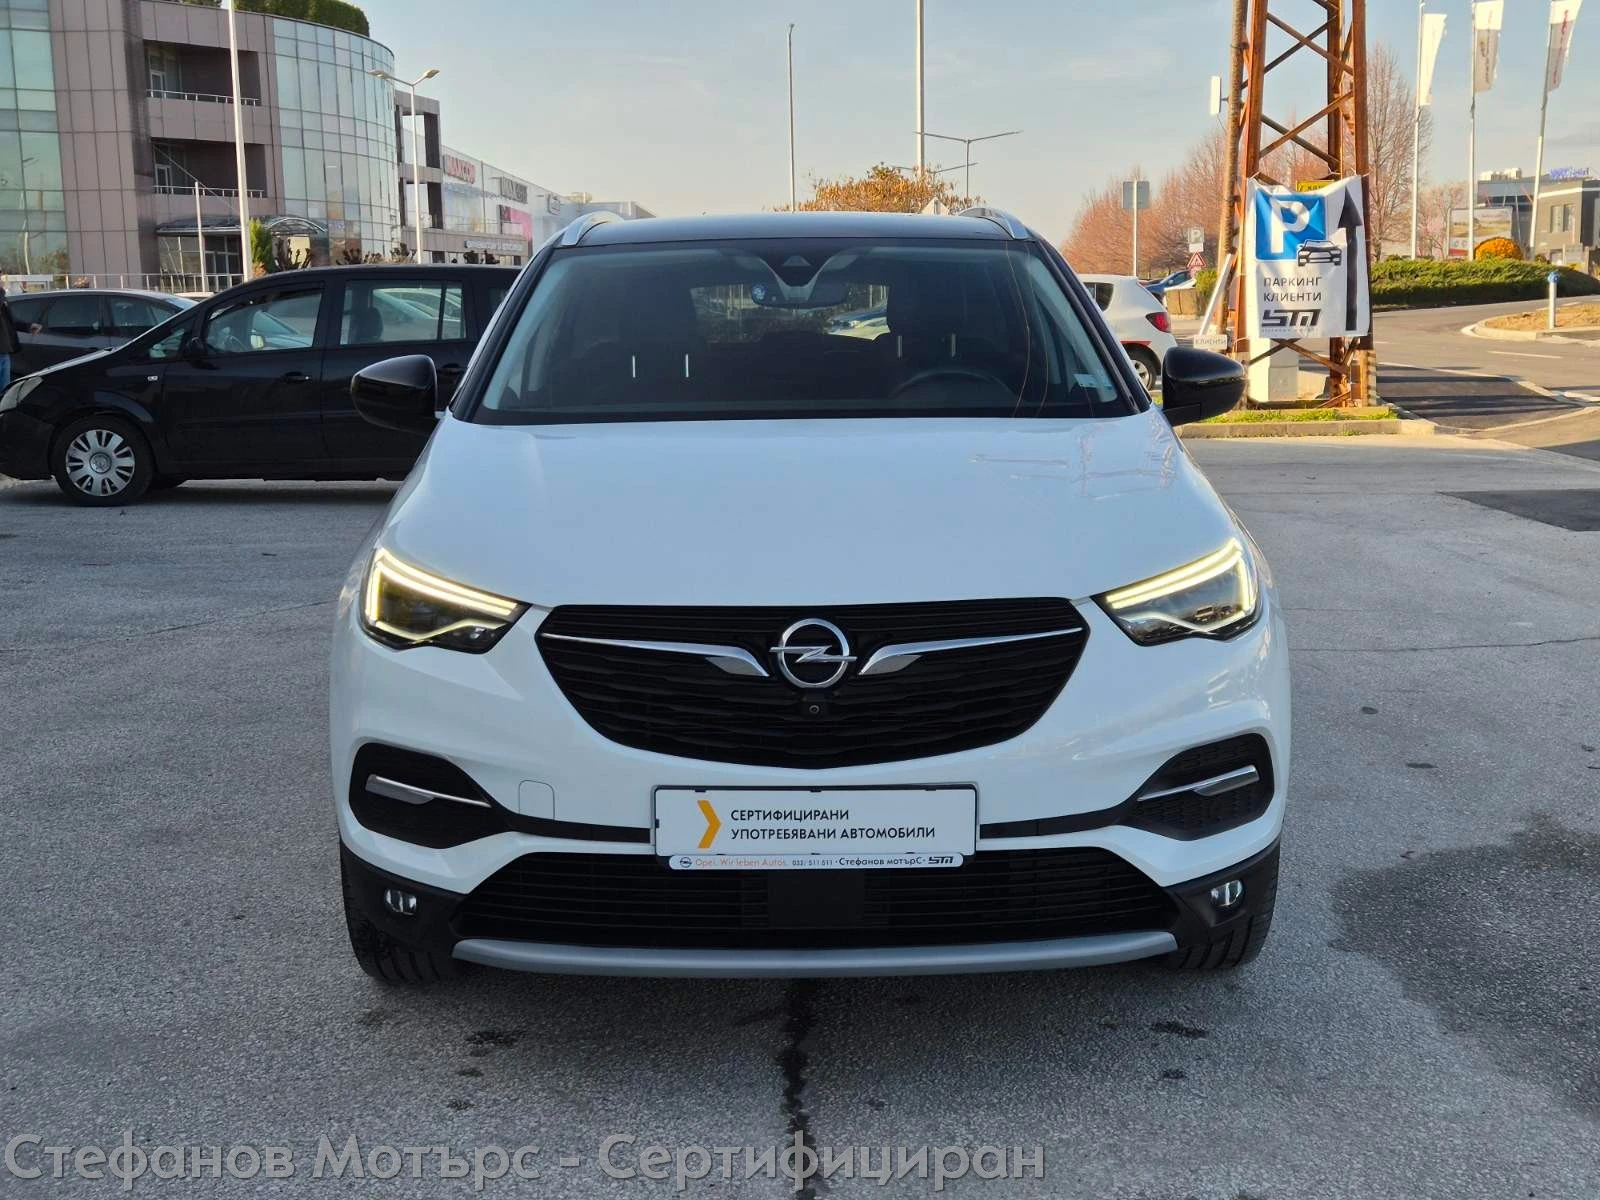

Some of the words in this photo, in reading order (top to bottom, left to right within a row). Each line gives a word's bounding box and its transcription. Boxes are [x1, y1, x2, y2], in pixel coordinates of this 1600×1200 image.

[1270, 200, 1310, 254] P
[1263, 277, 1322, 287] ПАРКИНГ
[1263, 292, 1322, 302] КЛИЕНТИ
[730, 809, 849, 823] СЕРТИФИЦИРАНИ
[731, 828, 837, 840] УПОТРЕБЯВАНИ
[840, 827, 936, 839] АВТОМОБИЛИ
[838, 857, 885, 867] Стефанов
